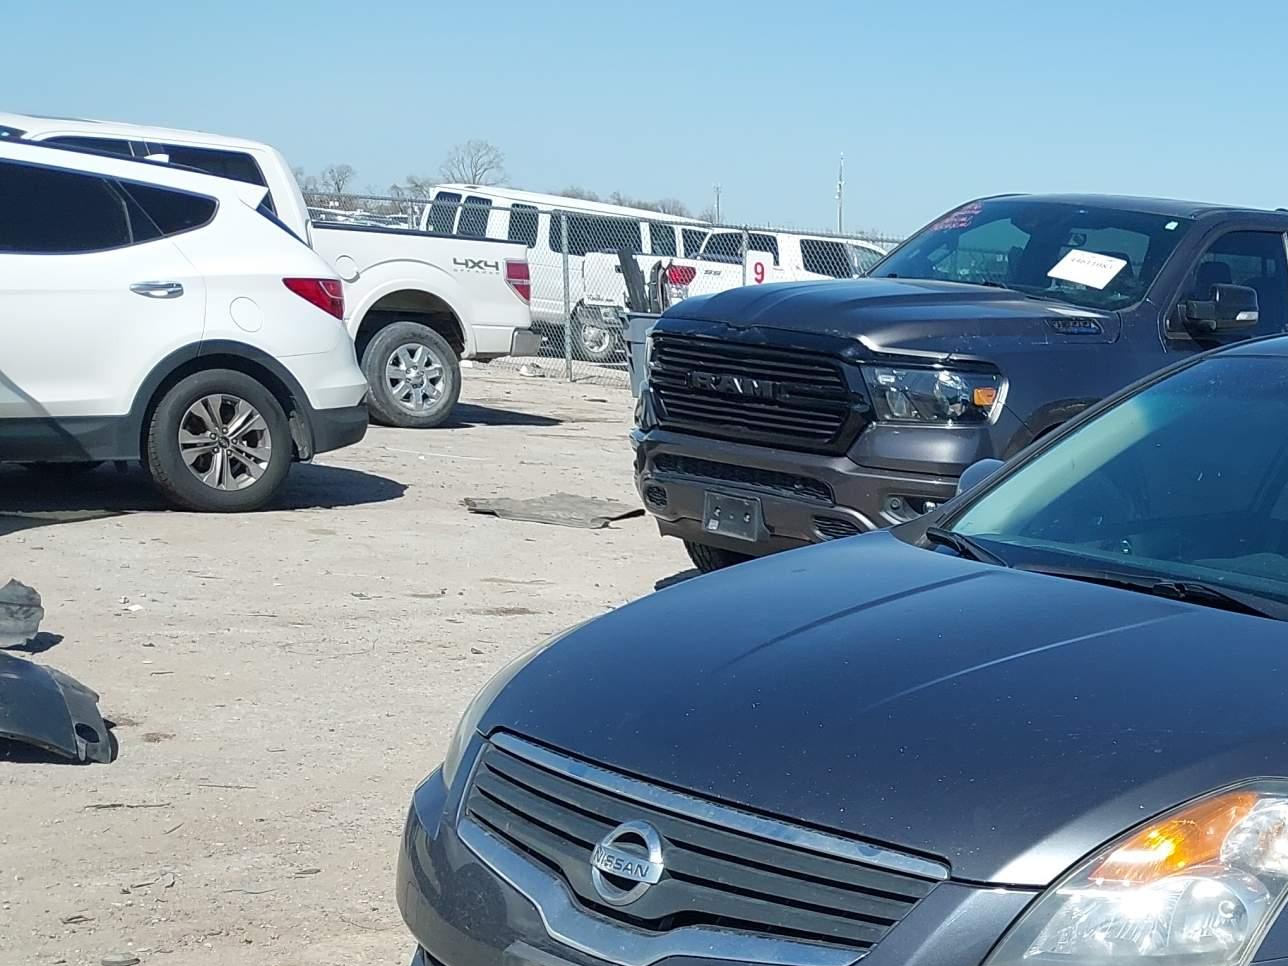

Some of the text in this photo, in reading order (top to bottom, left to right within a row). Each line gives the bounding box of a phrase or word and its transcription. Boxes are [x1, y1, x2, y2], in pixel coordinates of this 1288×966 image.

[754, 261, 765, 284] 9
[689, 371, 775, 398] RAM
[593, 845, 650, 878] NISSAN
